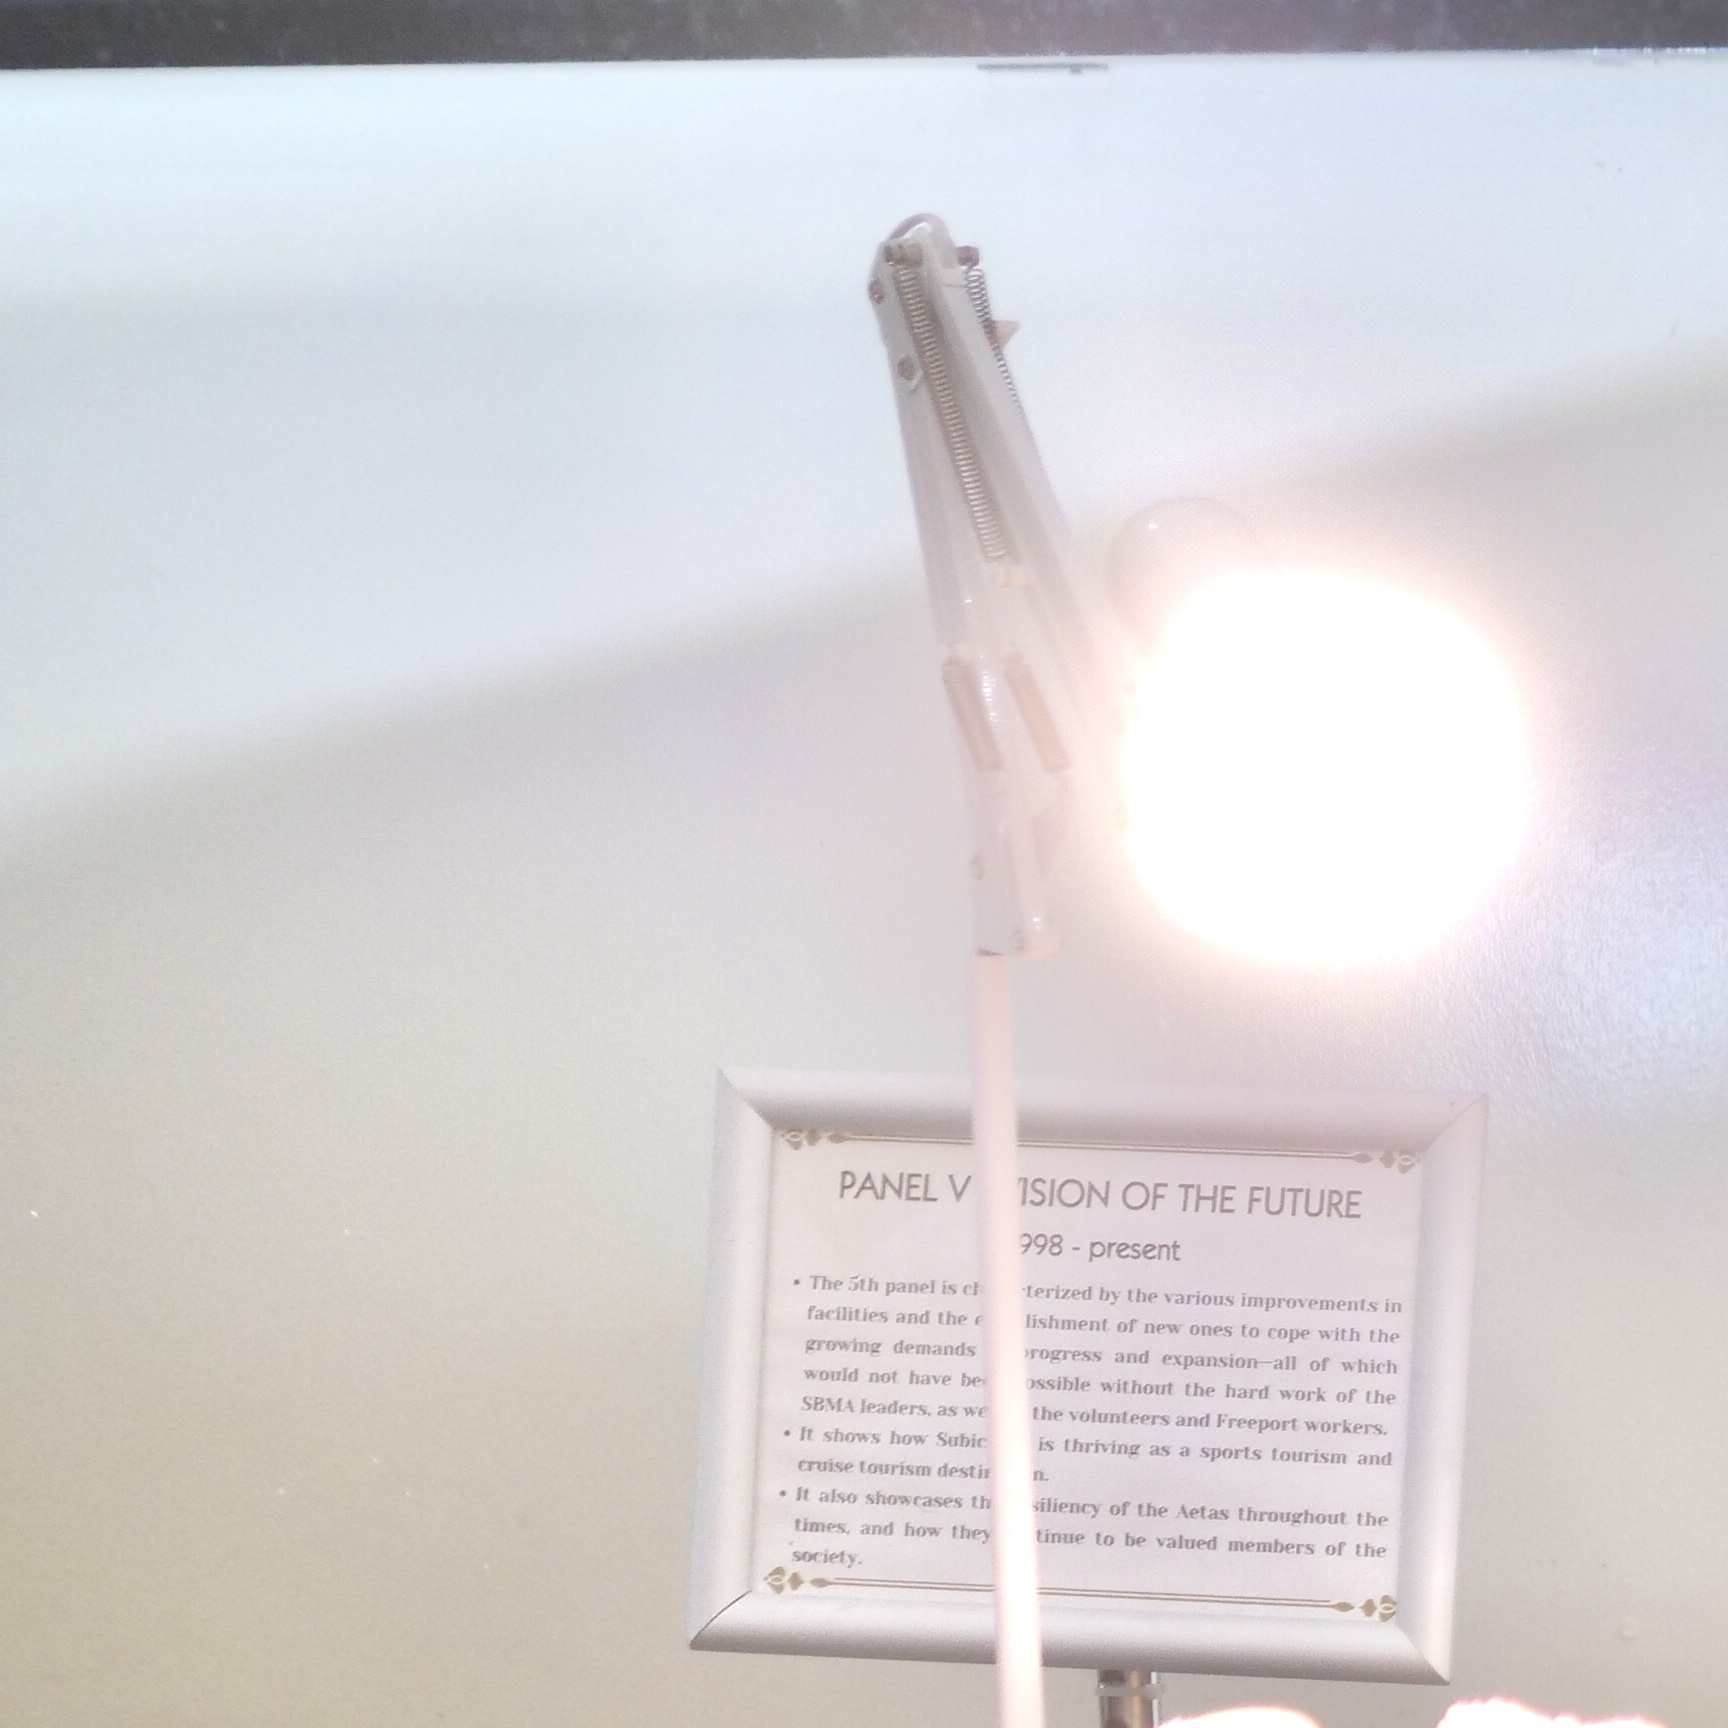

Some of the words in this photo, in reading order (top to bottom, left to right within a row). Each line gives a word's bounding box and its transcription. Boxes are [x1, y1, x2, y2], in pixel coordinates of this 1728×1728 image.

[839, 1169, 938, 1203] PANEL
[948, 1173, 972, 1204] V
[1017, 1176, 1111, 1210] ISION
[1121, 1180, 1169, 1212] OF
[1177, 1183, 1237, 1215] THE
[1247, 1185, 1363, 1219] FUTURE
[1019, 1232, 1064, 1258] 998
[1088, 1240, 1181, 1264] present
[809, 1274, 844, 1292] The
[848, 1275, 879, 1292] 5th
[884, 1279, 936, 1297] panel
[941, 1280, 958, 1296] is
[1099, 1286, 1122, 1306] by
[1127, 1287, 1159, 1304] the
[1164, 1290, 1235, 1307] various
[1241, 1291, 1378, 1313] improvements
[1384, 1298, 1402, 1314] in
[807, 1305, 889, 1323] facilities
[895, 1309, 931, 1325] and
[938, 1310, 968, 1326] the
[1117, 1318, 1139, 1334] of
[1144, 1322, 1184, 1335] new
[1189, 1323, 1235, 1338] ones
[1241, 1323, 1261, 1339] to
[1267, 1327, 1311, 1344] cope
[1318, 1327, 1361, 1343] with
[1369, 1328, 1400, 1344] the
[805, 1336, 883, 1358] growing
[892, 1339, 977, 1358] demands
[1024, 1347, 1103, 1365] rogress
[1114, 1349, 1150, 1365] and
[1309, 1356, 1331, 1373] of
[1340, 1358, 1398, 1375] which
[803, 1366, 860, 1383] would
[868, 1370, 899, 1385] not
[908, 1369, 952, 1387] have
[961, 1370, 988, 1387] be
[1100, 1378, 1175, 1397] without
[1185, 1381, 1216, 1398] the
[1225, 1383, 1271, 1400] hard
[1278, 1386, 1327, 1403] work
[1336, 1387, 1358, 1404] of
[1365, 1389, 1397, 1405] the
[801, 1396, 855, 1414] SBMA
[859, 1398, 932, 1418] leaders,
[937, 1404, 959, 1418] as
[962, 1401, 988, 1418] we
[1032, 1405, 1064, 1422] the
[1068, 1407, 1171, 1427] volunteers
[1175, 1412, 1211, 1429] and
[1216, 1412, 1299, 1435] Freeport
[1304, 1418, 1388, 1436] workers.
[799, 1426, 814, 1442] It
[822, 1427, 881, 1445] shows
[889, 1429, 929, 1446] how
[936, 1430, 987, 1449] Subic
[1038, 1435, 1055, 1452] is
[1064, 1438, 1142, 1459] thriving
[1148, 1444, 1172, 1458] as
[1179, 1445, 1191, 1458] a
[1199, 1445, 1263, 1463] sports
[1271, 1446, 1348, 1465] tourism
[1357, 1451, 1393, 1467] and
[797, 1457, 856, 1474] cruise
[859, 1460, 933, 1478] tourism
[795, 1485, 811, 1502] It
[818, 1488, 858, 1505] also
[865, 1490, 963, 1513] showcases
[971, 1494, 992, 1511] th
[1109, 1500, 1131, 1517] of
[1137, 1501, 1169, 1519] the
[1175, 1504, 1230, 1521] Aetas
[1238, 1506, 1349, 1528] throughout
[1357, 1511, 1389, 1528] the
[794, 1517, 850, 1537] times,
[860, 1521, 894, 1537] and
[904, 1521, 943, 1539] how
[951, 1524, 991, 1544] they
[1036, 1528, 1086, 1546] tinue
[1095, 1531, 1115, 1547] to
[1124, 1531, 1147, 1548] be
[1155, 1533, 1218, 1552] valued
[1227, 1537, 1316, 1556] members
[1324, 1540, 1347, 1557] of
[1355, 1541, 1388, 1559] the
[791, 1549, 863, 1568] society.
